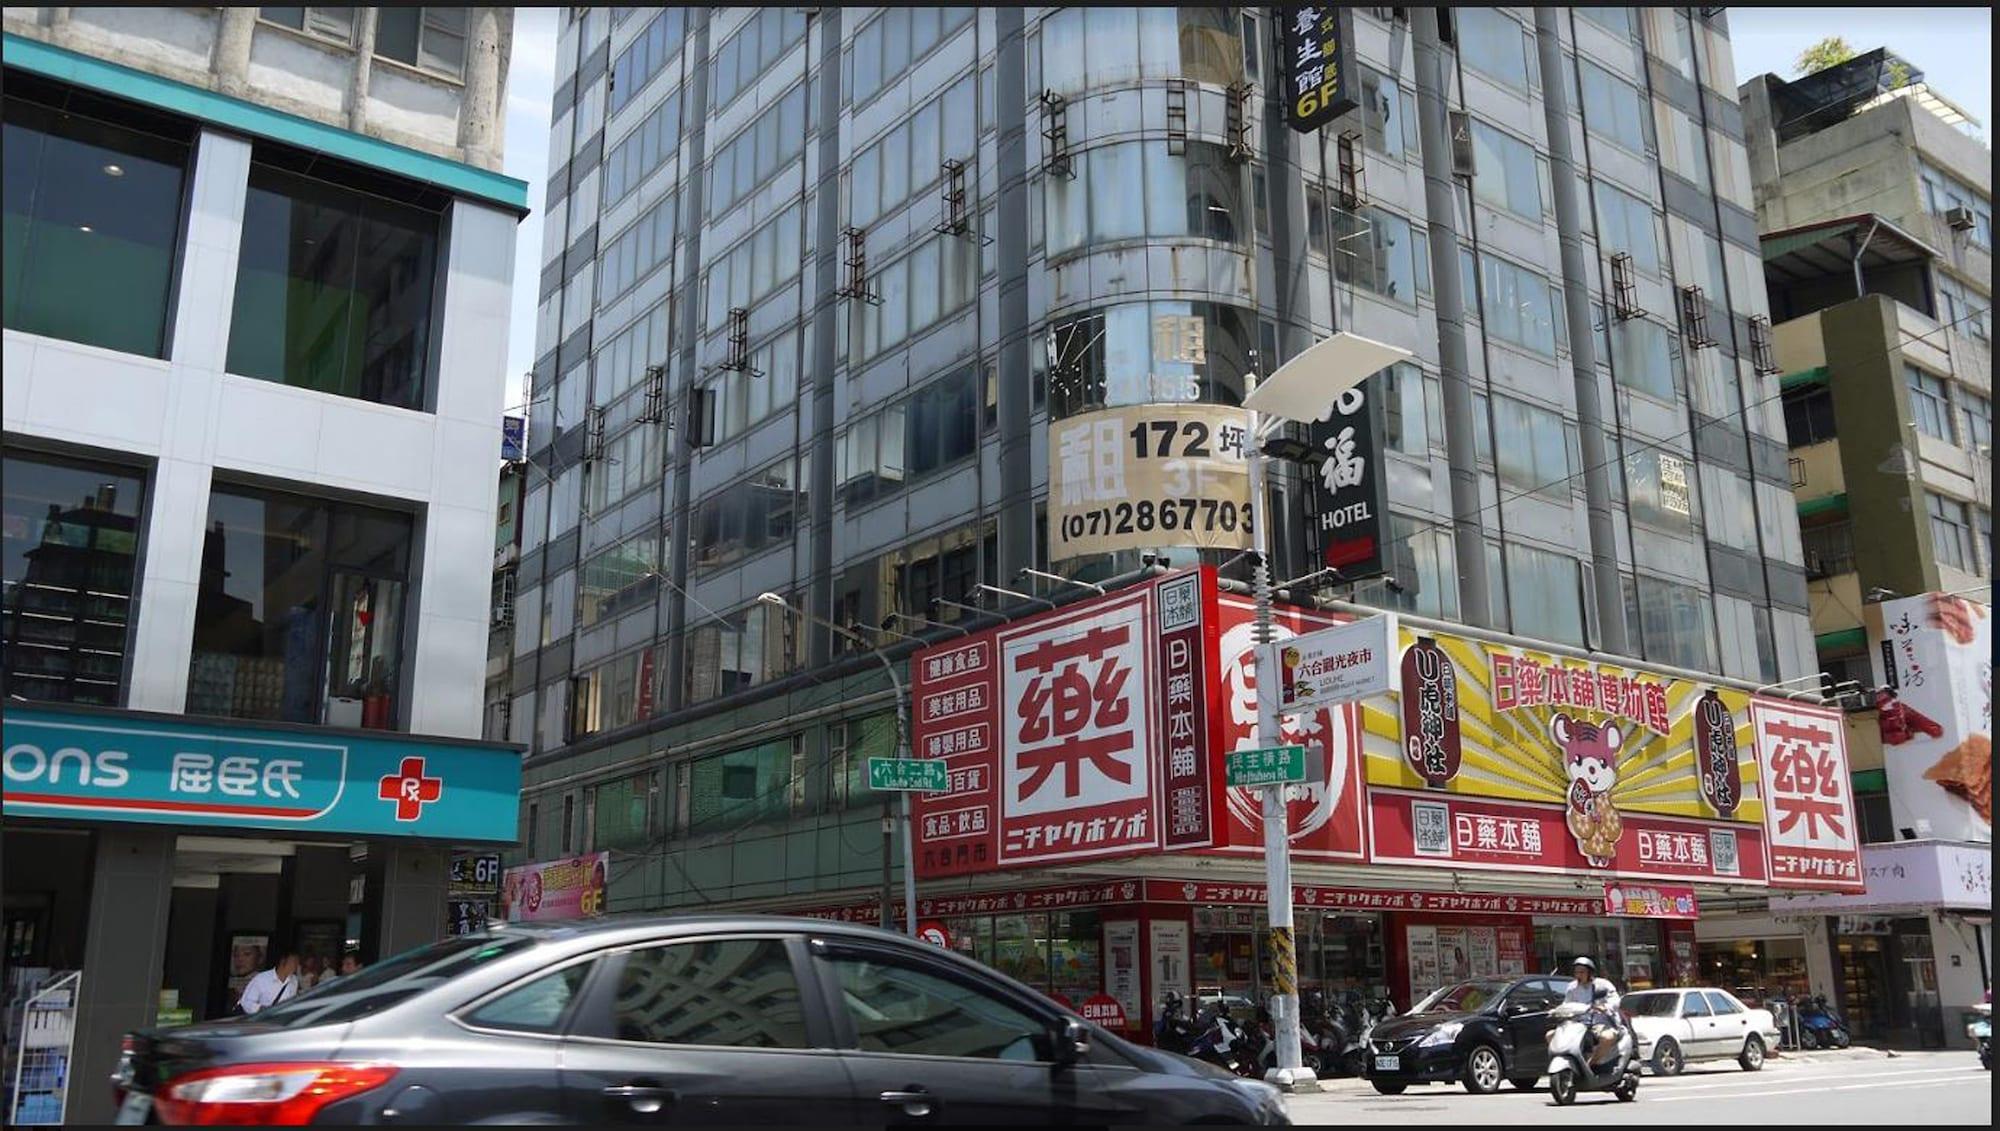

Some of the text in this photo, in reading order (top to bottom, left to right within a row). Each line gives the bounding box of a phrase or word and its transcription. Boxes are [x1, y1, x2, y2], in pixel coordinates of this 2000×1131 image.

[1297, 79, 1337, 118] 6F
[1130, 420, 1210, 458] 172
[1060, 418, 1127, 506] 租
[1321, 501, 1372, 530] HOTEL
[1015, 625, 1134, 803] 藥
[169, 751, 304, 799] 屈臣氏
[880, 760, 935, 777] 六合二路
[1765, 720, 1846, 840] 藥
